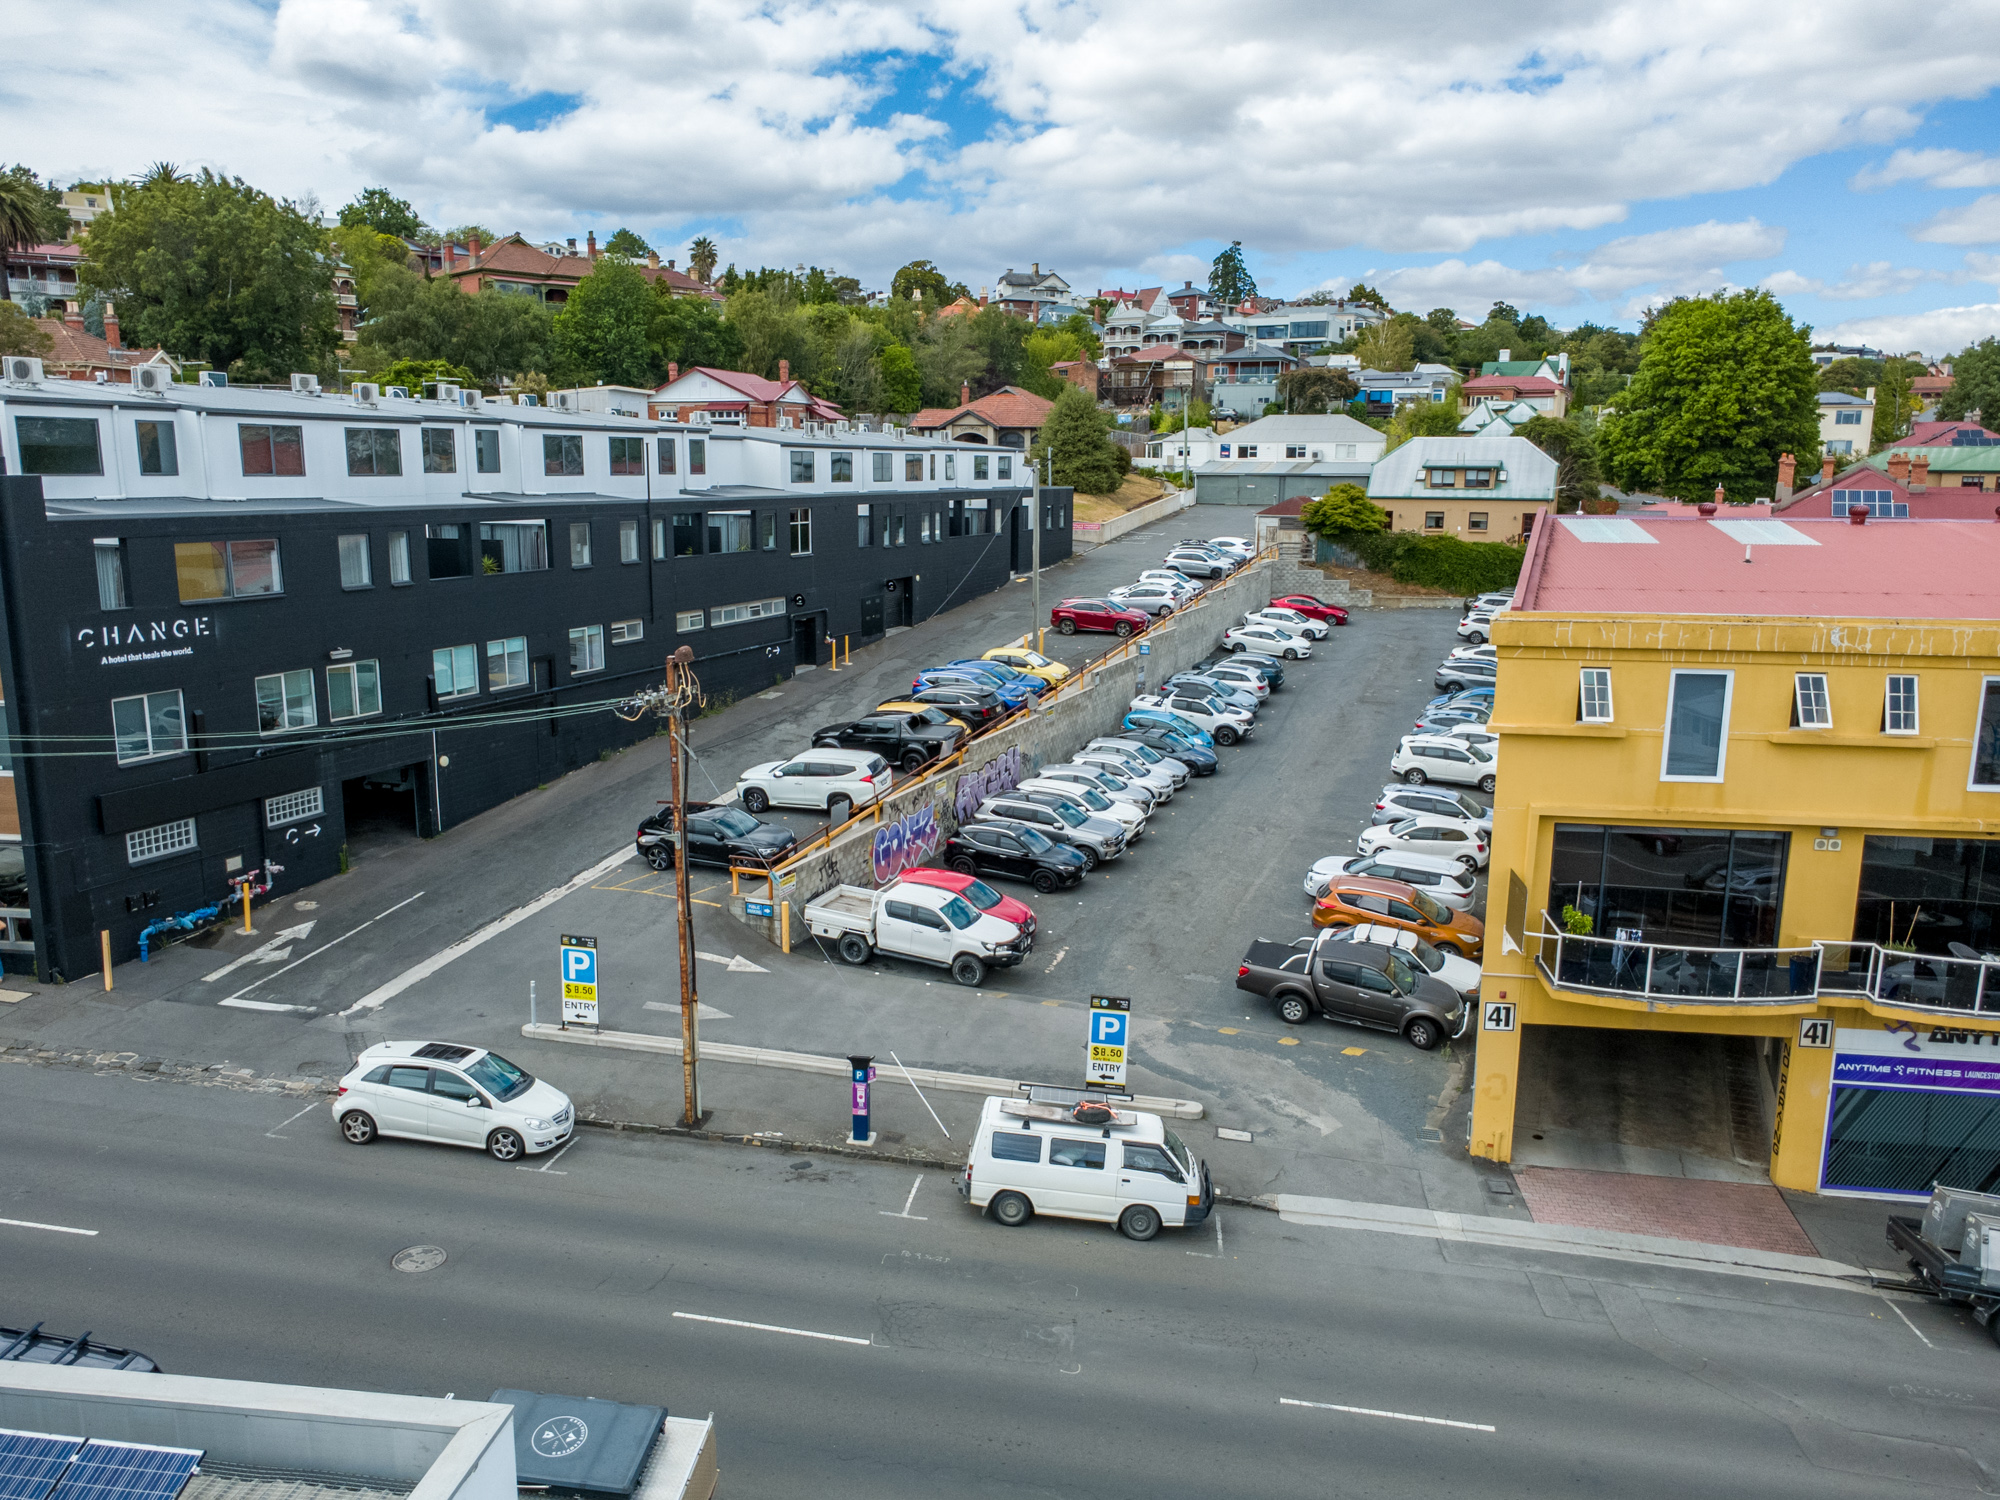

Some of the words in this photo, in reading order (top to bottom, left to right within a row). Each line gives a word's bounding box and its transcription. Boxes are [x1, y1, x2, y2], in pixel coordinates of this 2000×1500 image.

[78, 617, 209, 648] CHANGE
[101, 656, 108, 665] A
[109, 654, 127, 664] hotel
[128, 653, 142, 662] that
[143, 651, 160, 660] heals
[161, 649, 172, 658] the
[172, 647, 193, 656] world.
[568, 950, 590, 980] P
[564, 1001, 596, 1011] ENTRY
[1487, 1006, 1511, 1027] 41
[1098, 1016, 1120, 1041] P
[1803, 1022, 1829, 1044] 41
[1782, 1042, 1791, 1069] NO
[856, 1071, 863, 1079] P
[1092, 1063, 1121, 1073] ENTRY
[1837, 1063, 1891, 1073] ANYTIME
[1906, 1067, 1961, 1077] FITNESS
[1772, 1073, 1788, 1156] PARKING
